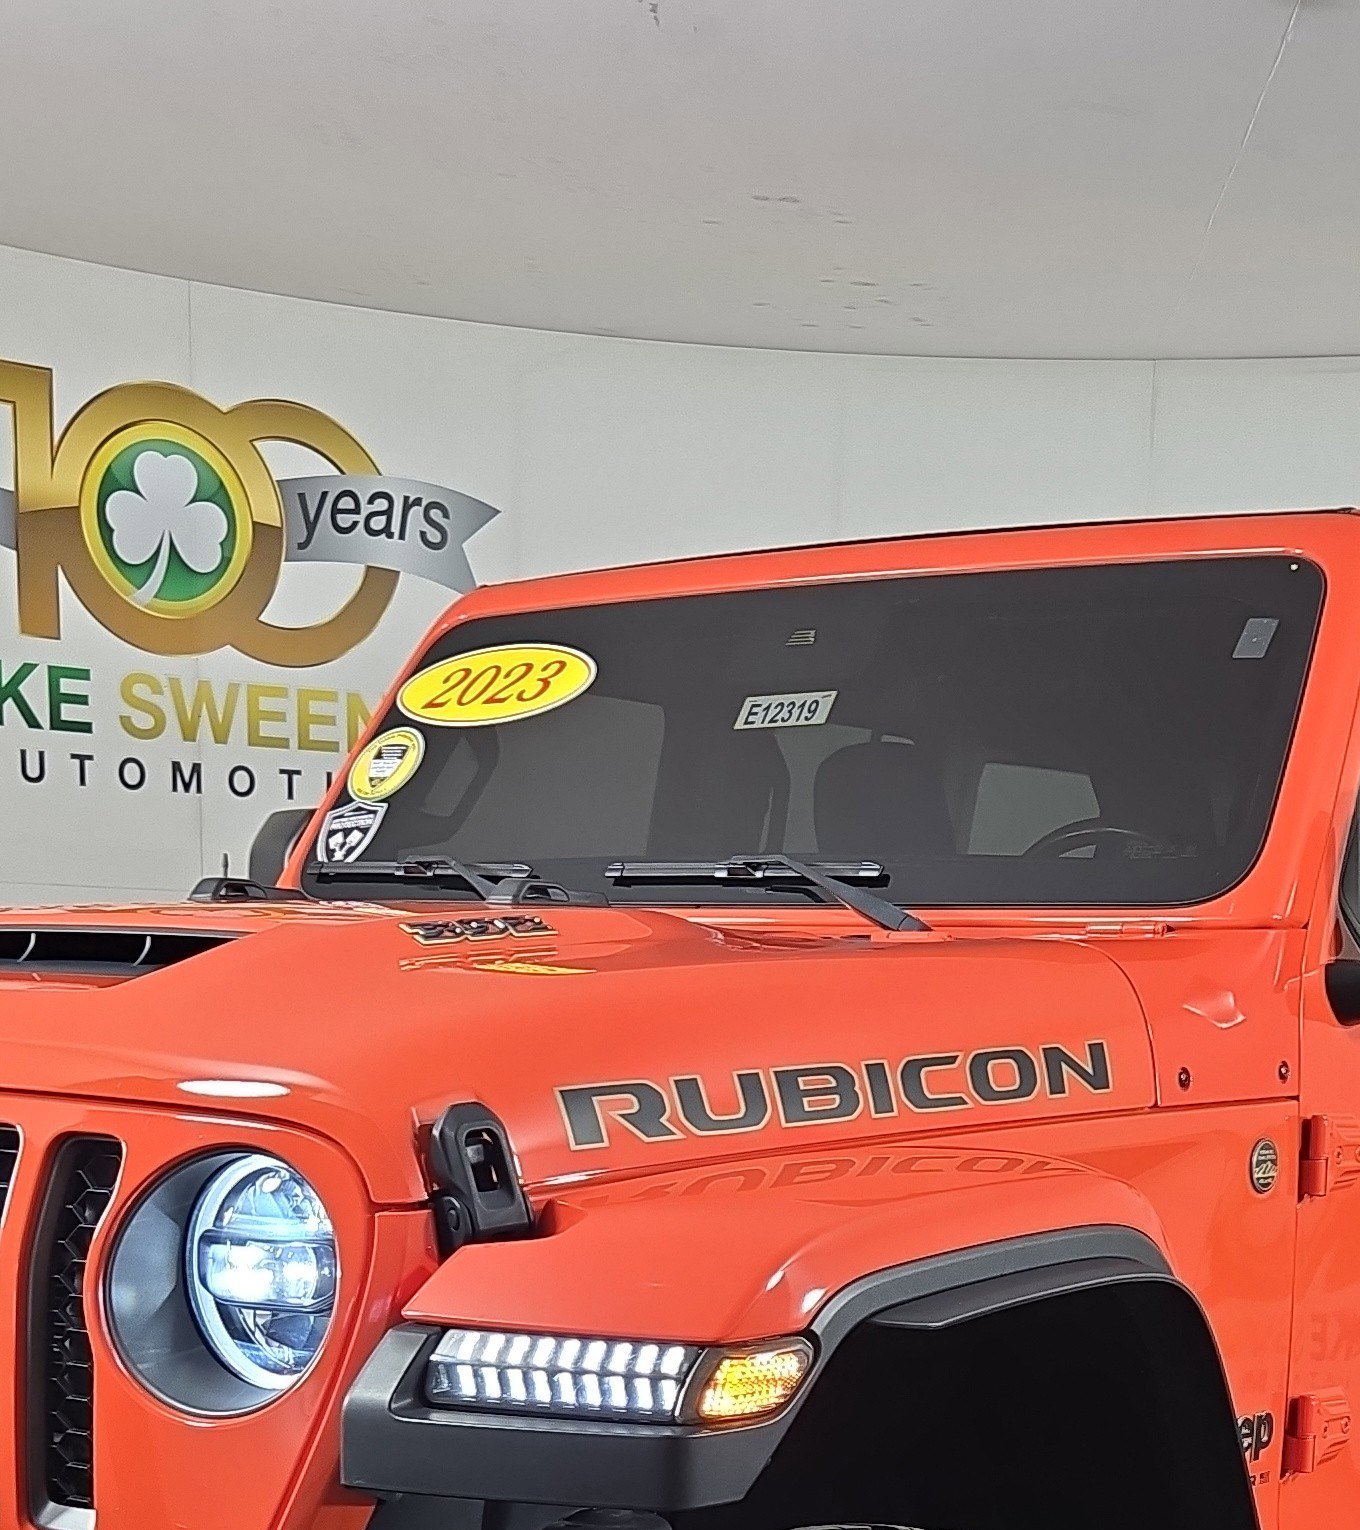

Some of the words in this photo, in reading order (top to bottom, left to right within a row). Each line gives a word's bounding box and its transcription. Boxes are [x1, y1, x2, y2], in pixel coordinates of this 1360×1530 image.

[296, 488, 451, 551] years
[421, 662, 569, 710] 2023
[743, 699, 820, 726] E12319
[554, 1038, 1113, 1151] RUBICON
